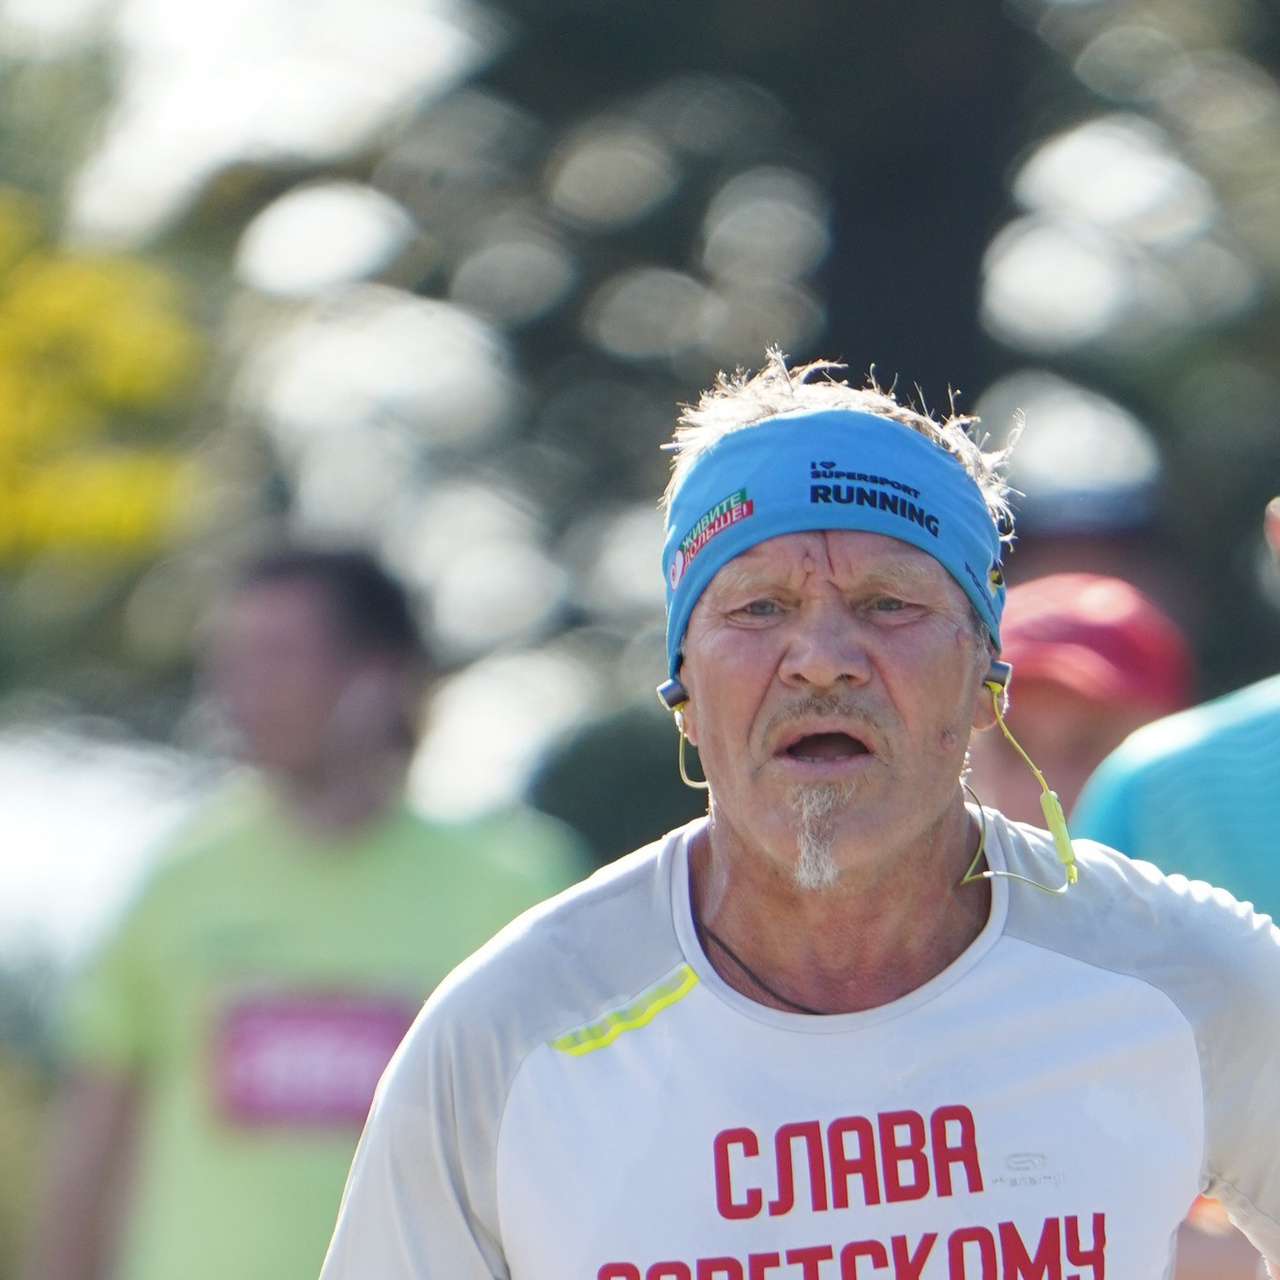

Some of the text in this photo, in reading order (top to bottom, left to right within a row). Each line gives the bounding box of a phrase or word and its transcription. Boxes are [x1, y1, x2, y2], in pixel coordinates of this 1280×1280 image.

[810, 470, 921, 499] SUPERSPORT
[810, 484, 940, 538] RUNNING
[682, 492, 742, 553] ЖИВИТЕ
[713, 1104, 985, 1221] СЛАВА
